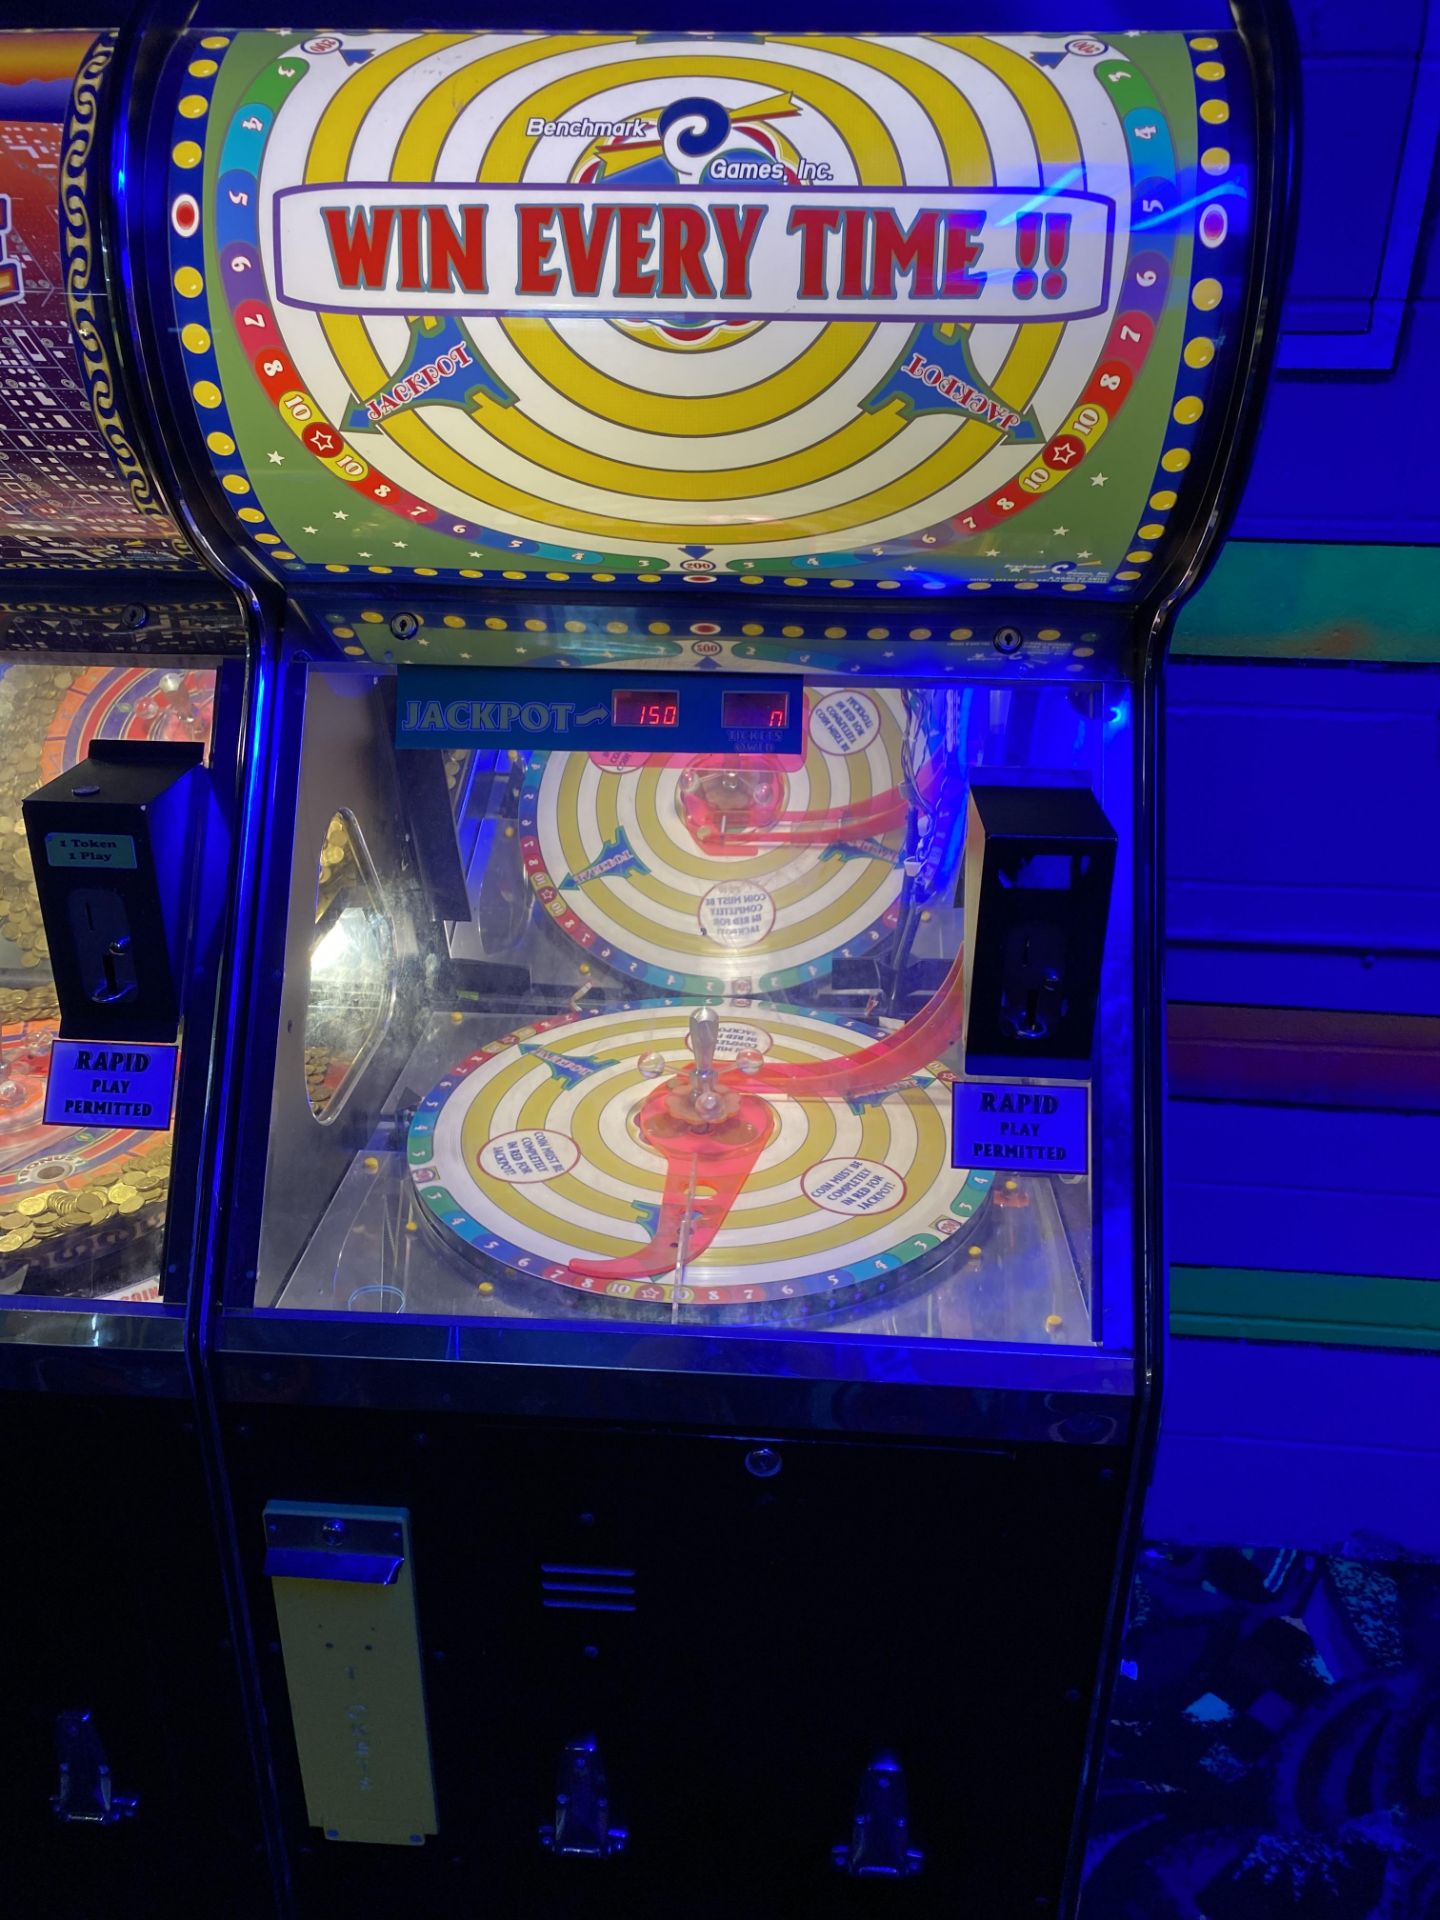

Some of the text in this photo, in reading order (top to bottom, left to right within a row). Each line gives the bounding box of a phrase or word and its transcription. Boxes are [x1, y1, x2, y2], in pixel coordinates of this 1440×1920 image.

[242, 117, 263, 131] 4
[525, 117, 650, 138] Benchmark
[1134, 126, 1157, 139] 4
[709, 158, 834, 181] Games, Inc.
[228, 190, 249, 206] 5
[1142, 199, 1164, 212] 5
[320, 203, 1073, 300] WIN EVERY TIME !!
[231, 256, 252, 273] 6
[1136, 269, 1157, 287] 6
[244, 313, 266, 329] 7
[1120, 325, 1141, 343] 7
[263, 359, 284, 377] 8
[365, 341, 473, 420] JACKPOT
[1100, 373, 1121, 391] 8
[901, 352, 1021, 431] JACKPOT
[284, 395, 312, 420] 10
[1073, 407, 1100, 435] 10
[336, 455, 363, 475] 10
[1024, 468, 1050, 490] 10
[374, 484, 391, 498] 8
[410, 506, 428, 517] 7
[996, 497, 1015, 511] 8
[453, 524, 467, 534] 6
[962, 516, 978, 530] 7
[685, 561, 712, 570] 200
[401, 700, 575, 733] JACKPOT
[639, 705, 677, 725] 150
[70, 838, 117, 849] Token
[69, 851, 112, 862] 1 Play
[74, 1051, 151, 1073] RAPID
[92, 1079, 131, 1094] PLAY
[64, 1100, 153, 1117] PERMITTED
[980, 1092, 1060, 1115] RAPID
[1000, 1121, 1040, 1137] PLAY
[506, 1141, 533, 1174] IN RED FOR
[520, 1137, 549, 1172] COMPLETELY
[533, 1131, 565, 1172] COIN MUST BE
[973, 1143, 1067, 1161] PERMITTED
[810, 1159, 864, 1199] COIN MUST BE
[826, 1168, 873, 1202] COMPLETELY
[841, 1174, 886, 1207] IN RED FOR
[857, 1181, 896, 1211] JACKPOT!
[484, 1241, 499, 1249] 5
[518, 1258, 531, 1267] 6
[550, 1269, 564, 1279] 7
[828, 1275, 840, 1286] 5
[581, 1278, 594, 1289] 8
[611, 1284, 631, 1295] 10
[782, 1284, 794, 1295] 6
[708, 1290, 720, 1300] 8
[743, 1289, 755, 1299] 7
